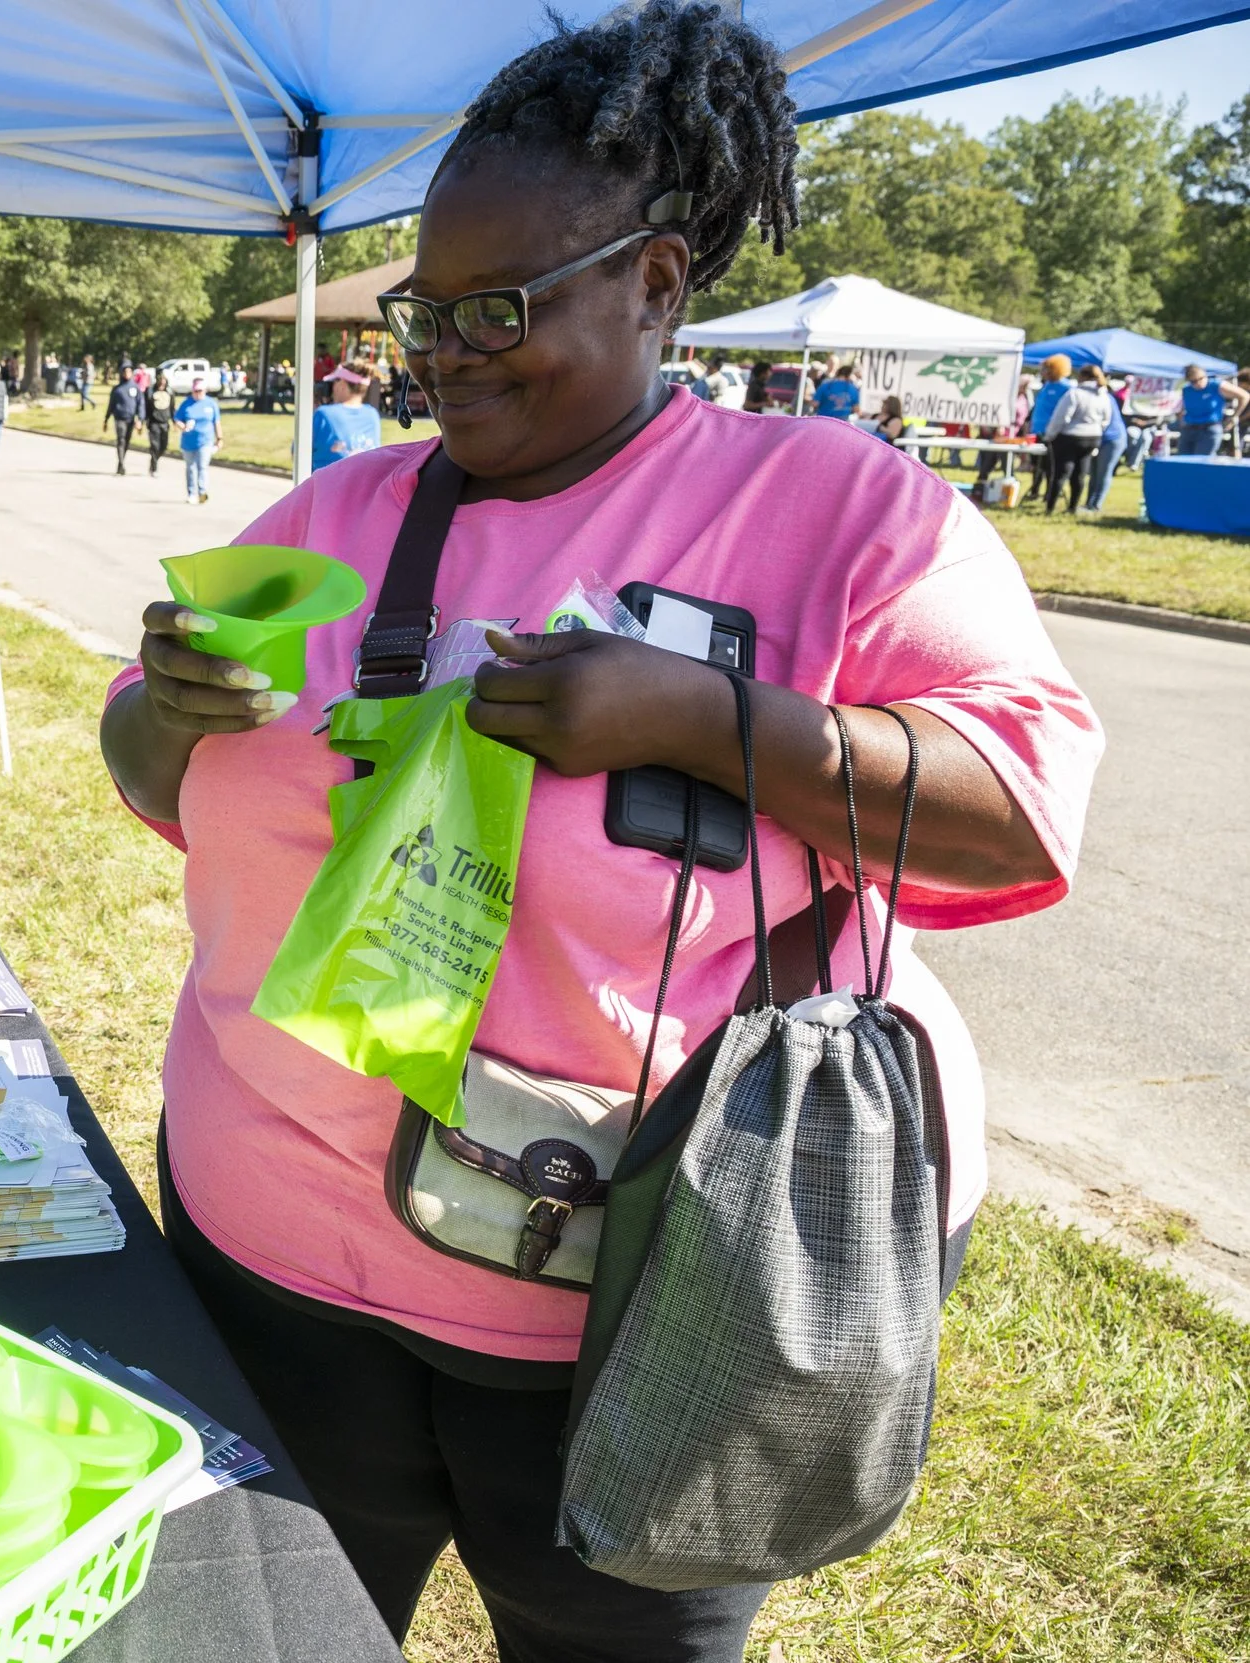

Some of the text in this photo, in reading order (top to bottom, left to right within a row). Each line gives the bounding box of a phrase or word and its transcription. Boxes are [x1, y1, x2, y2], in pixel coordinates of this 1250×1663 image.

[867, 350, 897, 391] NC
[393, 887, 503, 954] Member & Recipient
[441, 884, 479, 908] HEALTH
[381, 916, 489, 985] 1-877-685-2415
[407, 912, 474, 955] Service Line
[362, 930, 485, 1010] TrilliumHealthResources.org
